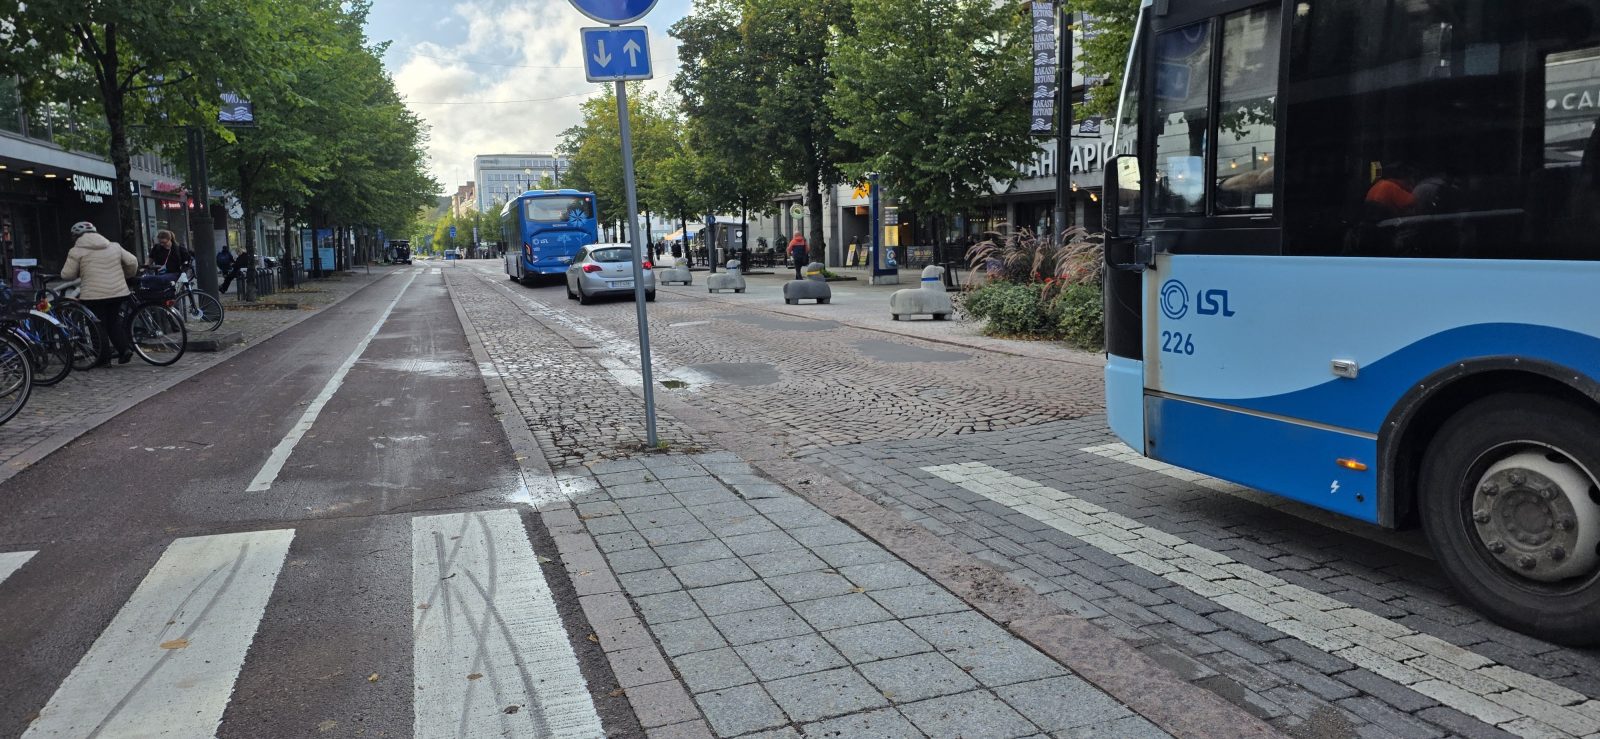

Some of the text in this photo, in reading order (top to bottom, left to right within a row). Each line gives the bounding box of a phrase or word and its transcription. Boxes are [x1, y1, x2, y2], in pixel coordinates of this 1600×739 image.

[1562, 90, 1600, 110] CA
[73, 174, 112, 195] SUOMALAINEN
[1196, 289, 1236, 317] LSL
[1162, 330, 1195, 356] 226
